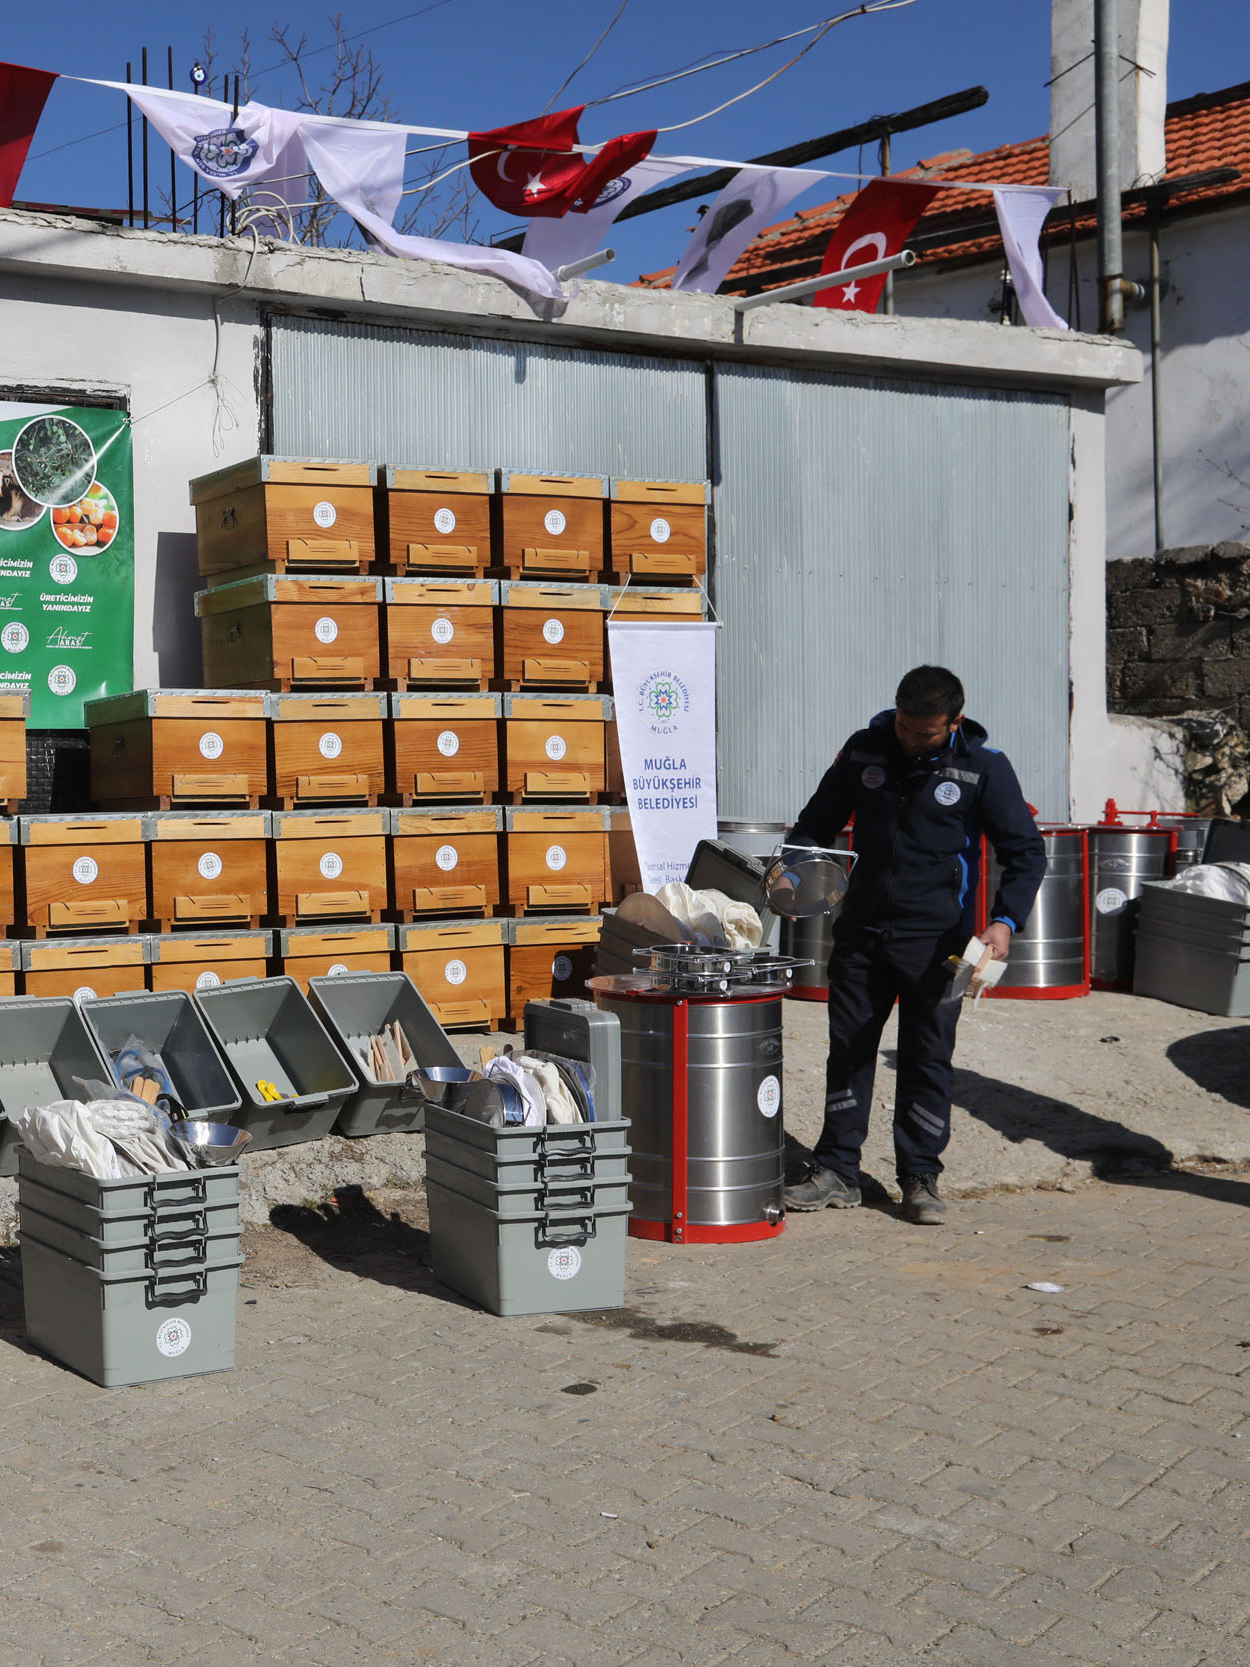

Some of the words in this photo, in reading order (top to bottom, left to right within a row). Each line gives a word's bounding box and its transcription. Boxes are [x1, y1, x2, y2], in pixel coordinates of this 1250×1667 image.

[40, 593, 93, 603] ÜRETİCİMİZİN
[42, 604, 91, 612] YANINDAYIZ
[46, 626, 93, 646] Ahmet
[639, 671, 671, 696] BÜYÜKŞEHİR
[673, 675, 689, 712] BELEDİYESİ
[651, 724, 678, 734] MUĞLA
[644, 756, 687, 770] MUĞLA
[632, 777, 702, 792] BÜYÜKŞEHİR
[638, 797, 698, 810] BELEDİYESİ
